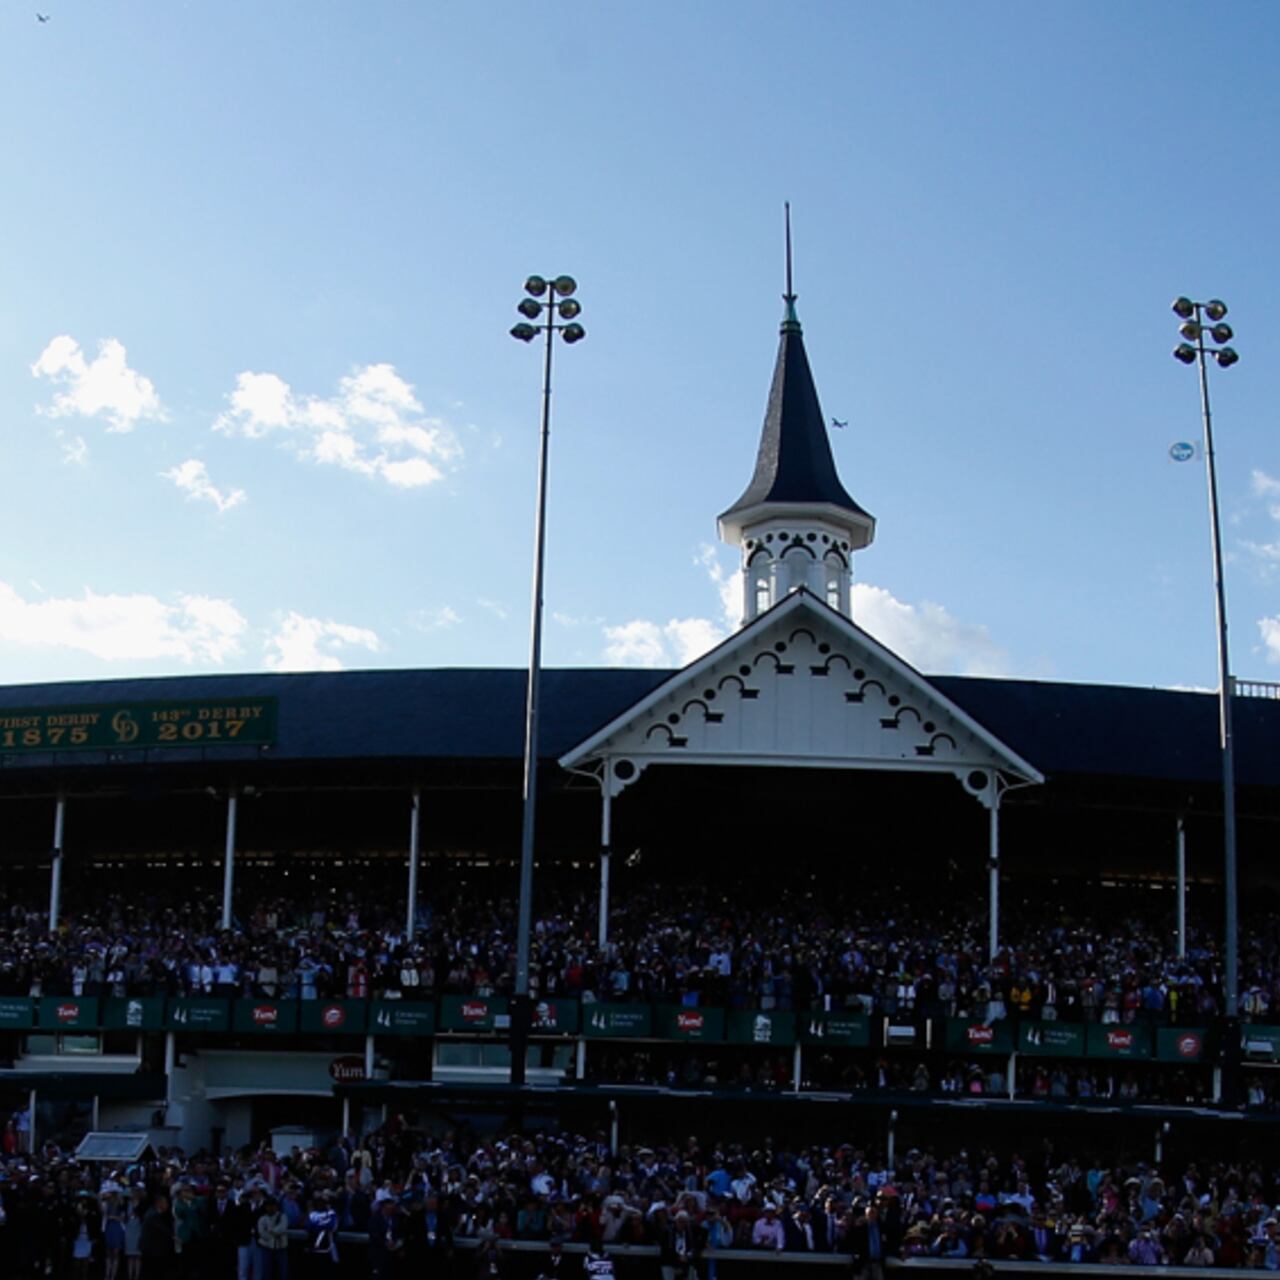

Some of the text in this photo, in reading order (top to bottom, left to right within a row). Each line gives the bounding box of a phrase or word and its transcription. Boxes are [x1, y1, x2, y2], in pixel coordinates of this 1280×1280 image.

[47, 713, 100, 727] DERBY
[198, 706, 263, 720] DERBY
[2, 726, 89, 747] 1875
[158, 720, 246, 741] 2017
